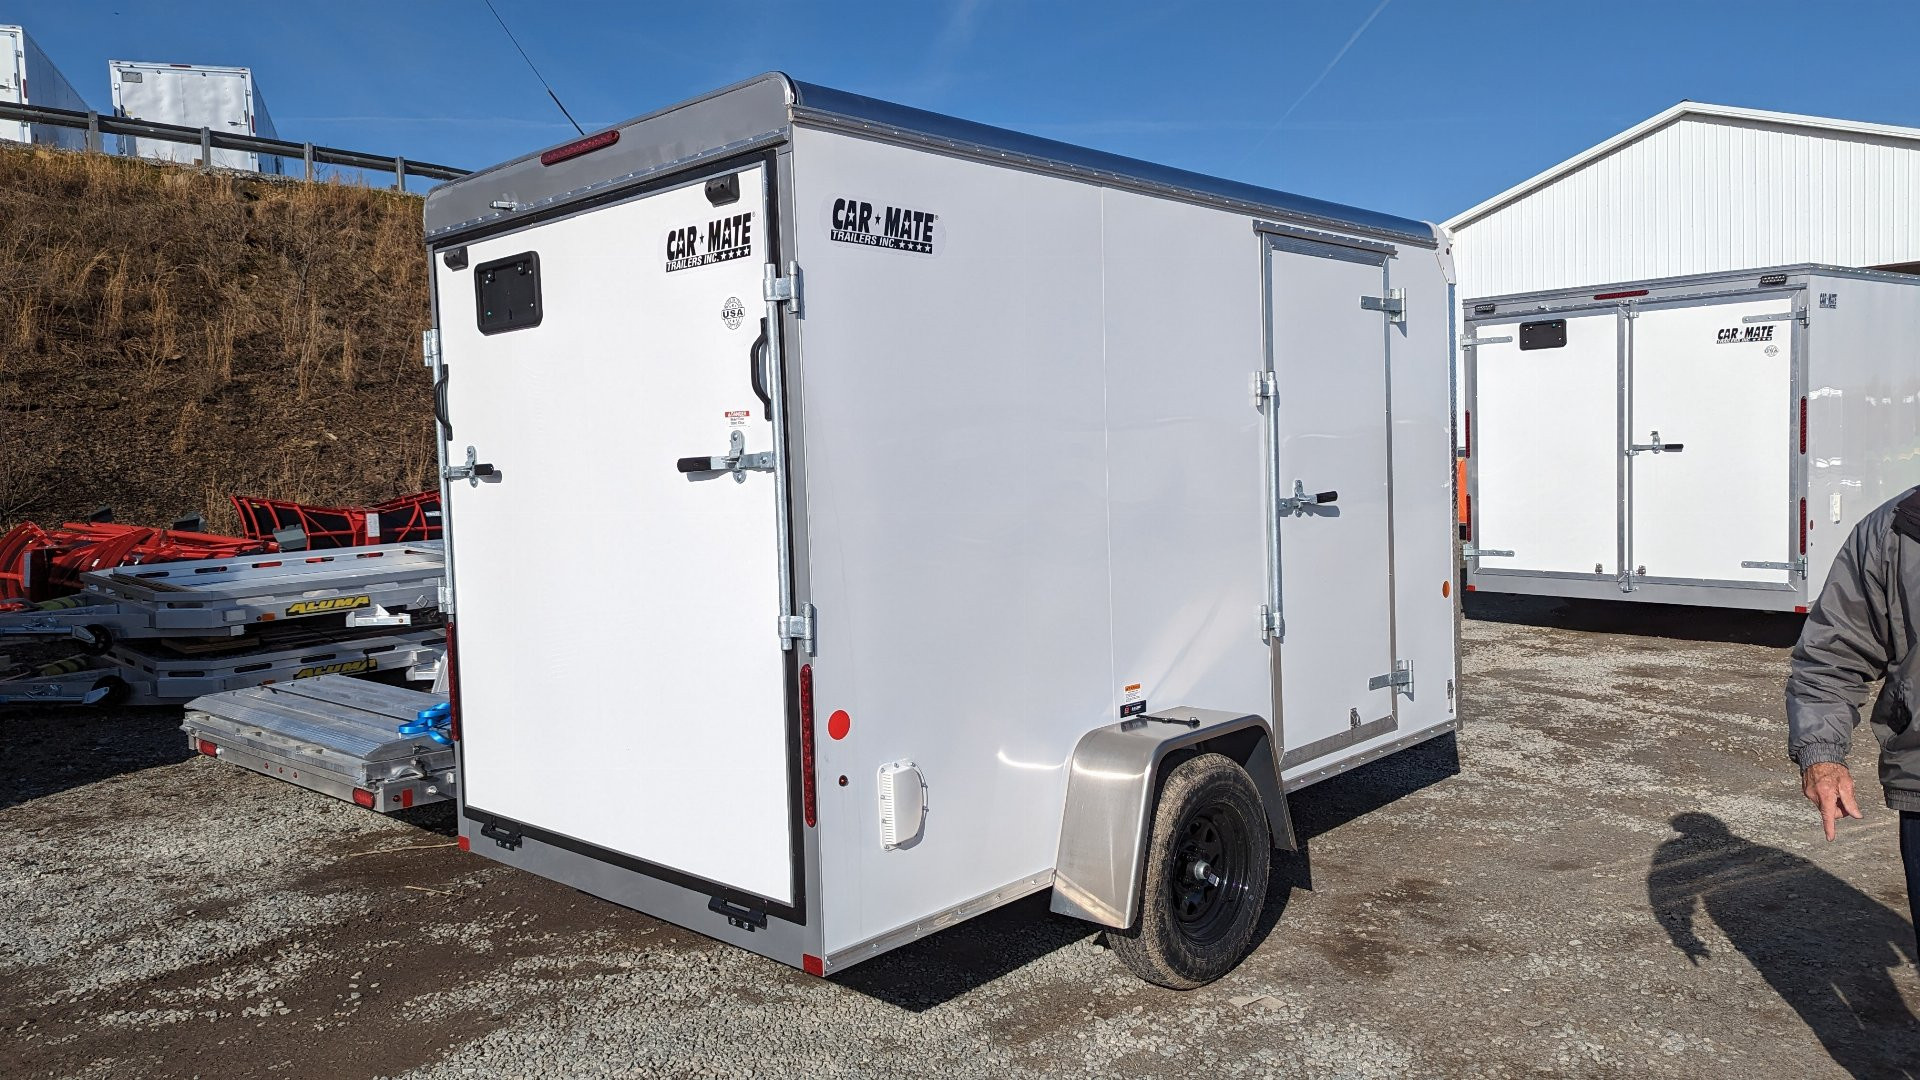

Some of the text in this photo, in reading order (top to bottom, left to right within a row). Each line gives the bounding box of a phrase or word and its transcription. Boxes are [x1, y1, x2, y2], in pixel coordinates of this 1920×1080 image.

[833, 198, 934, 241] CAR MATE
[667, 213, 751, 260] CAR MATE
[832, 230, 898, 248] TRAILERS INC.
[667, 252, 719, 271] TRAILERS INC.
[723, 309, 743, 319] USA
[1718, 326, 1773, 340] CAR MATE
[287, 596, 370, 615] ALUMA
[295, 659, 377, 679] ALUMA
